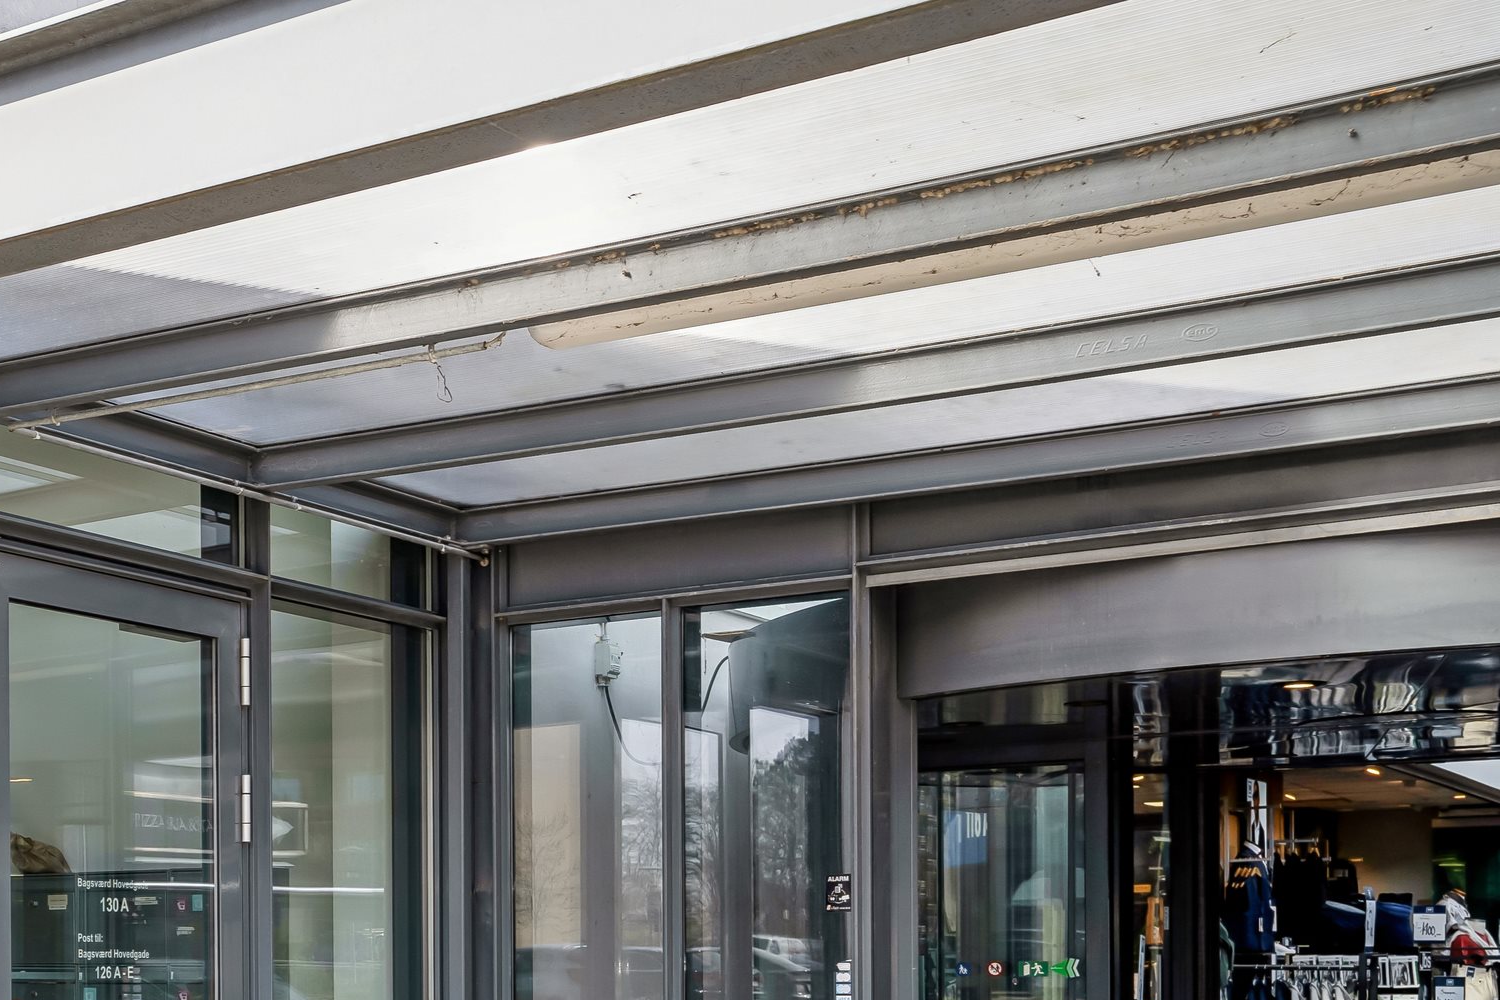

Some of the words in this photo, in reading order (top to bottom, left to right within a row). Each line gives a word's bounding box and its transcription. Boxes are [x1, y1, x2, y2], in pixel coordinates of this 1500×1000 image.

[1075, 333, 1148, 358] CELSA
[77, 878, 112, 889] Bagsværd
[100, 897, 119, 912] 130
[120, 898, 130, 912] A
[77, 933, 93, 943] Post
[94, 933, 104, 943] til:
[78, 949, 112, 960] Bagsværd
[113, 949, 150, 960] Hovedgade
[95, 966, 112, 979] 126
